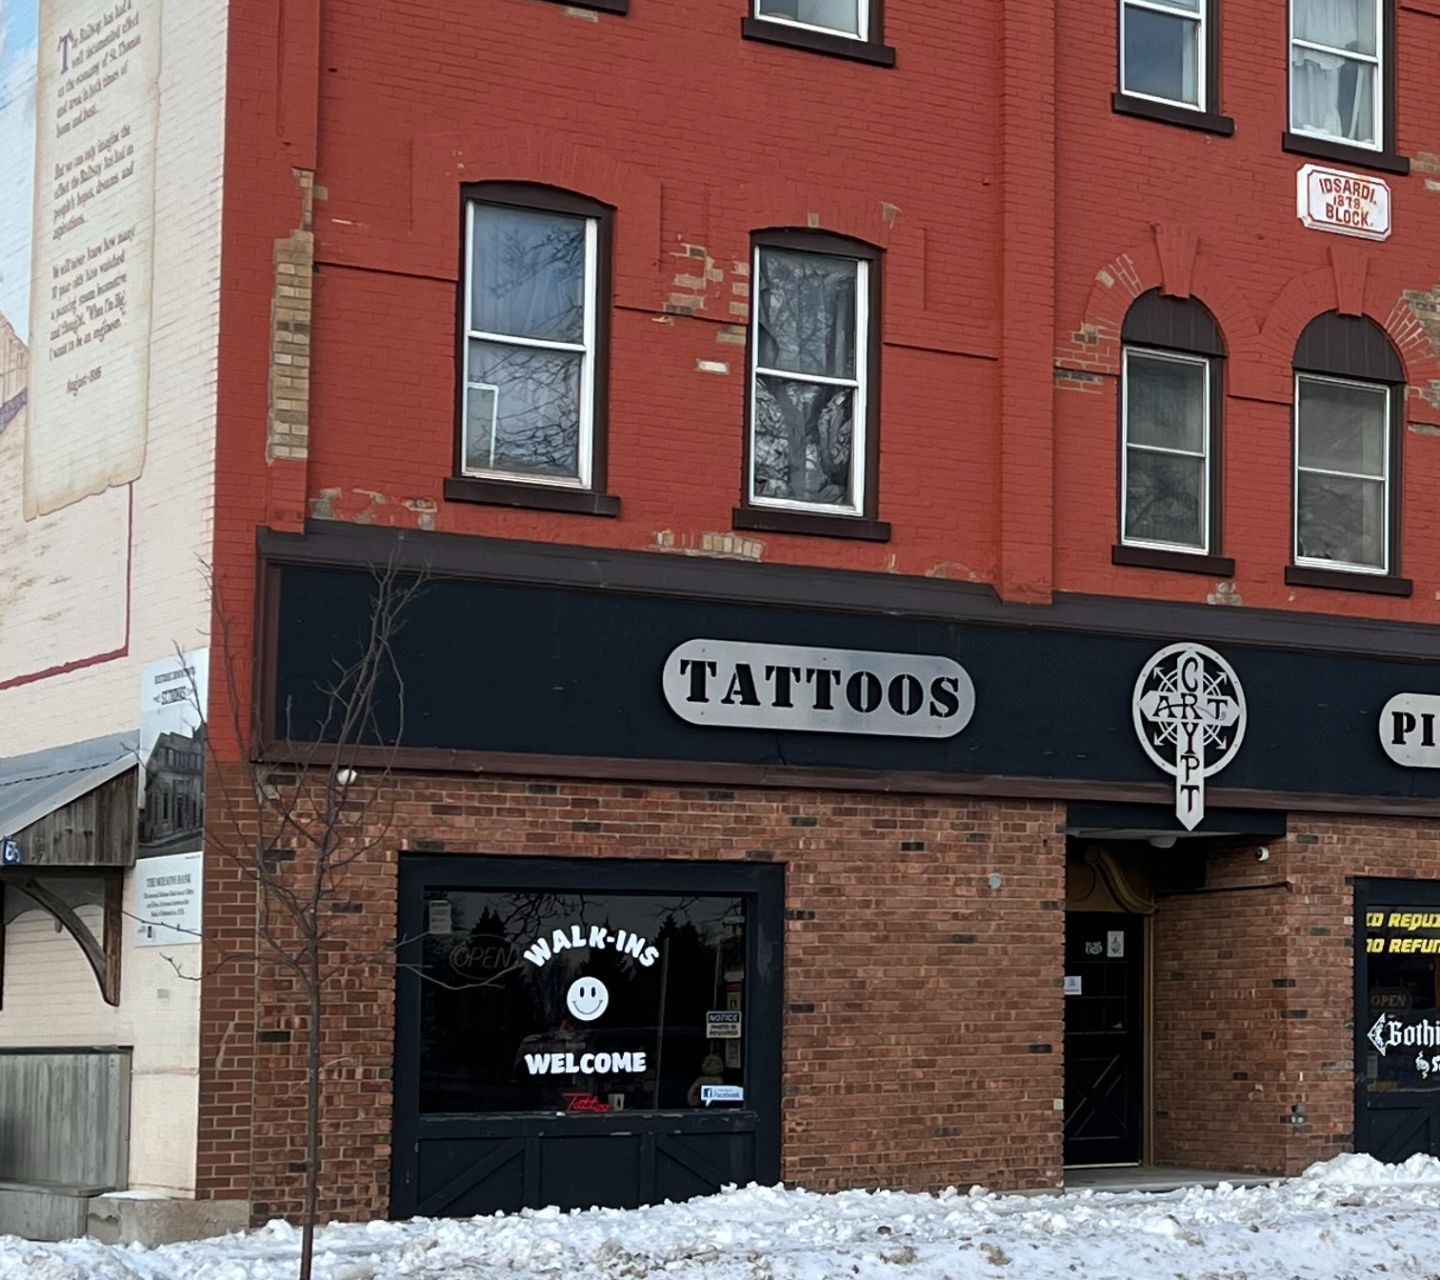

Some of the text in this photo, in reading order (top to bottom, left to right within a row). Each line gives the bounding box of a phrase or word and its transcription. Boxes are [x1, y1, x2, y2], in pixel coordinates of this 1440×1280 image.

[680, 658, 960, 719] TATTOOS
[523, 924, 659, 967] WALK-INS
[524, 1051, 646, 1074] WELCOME
